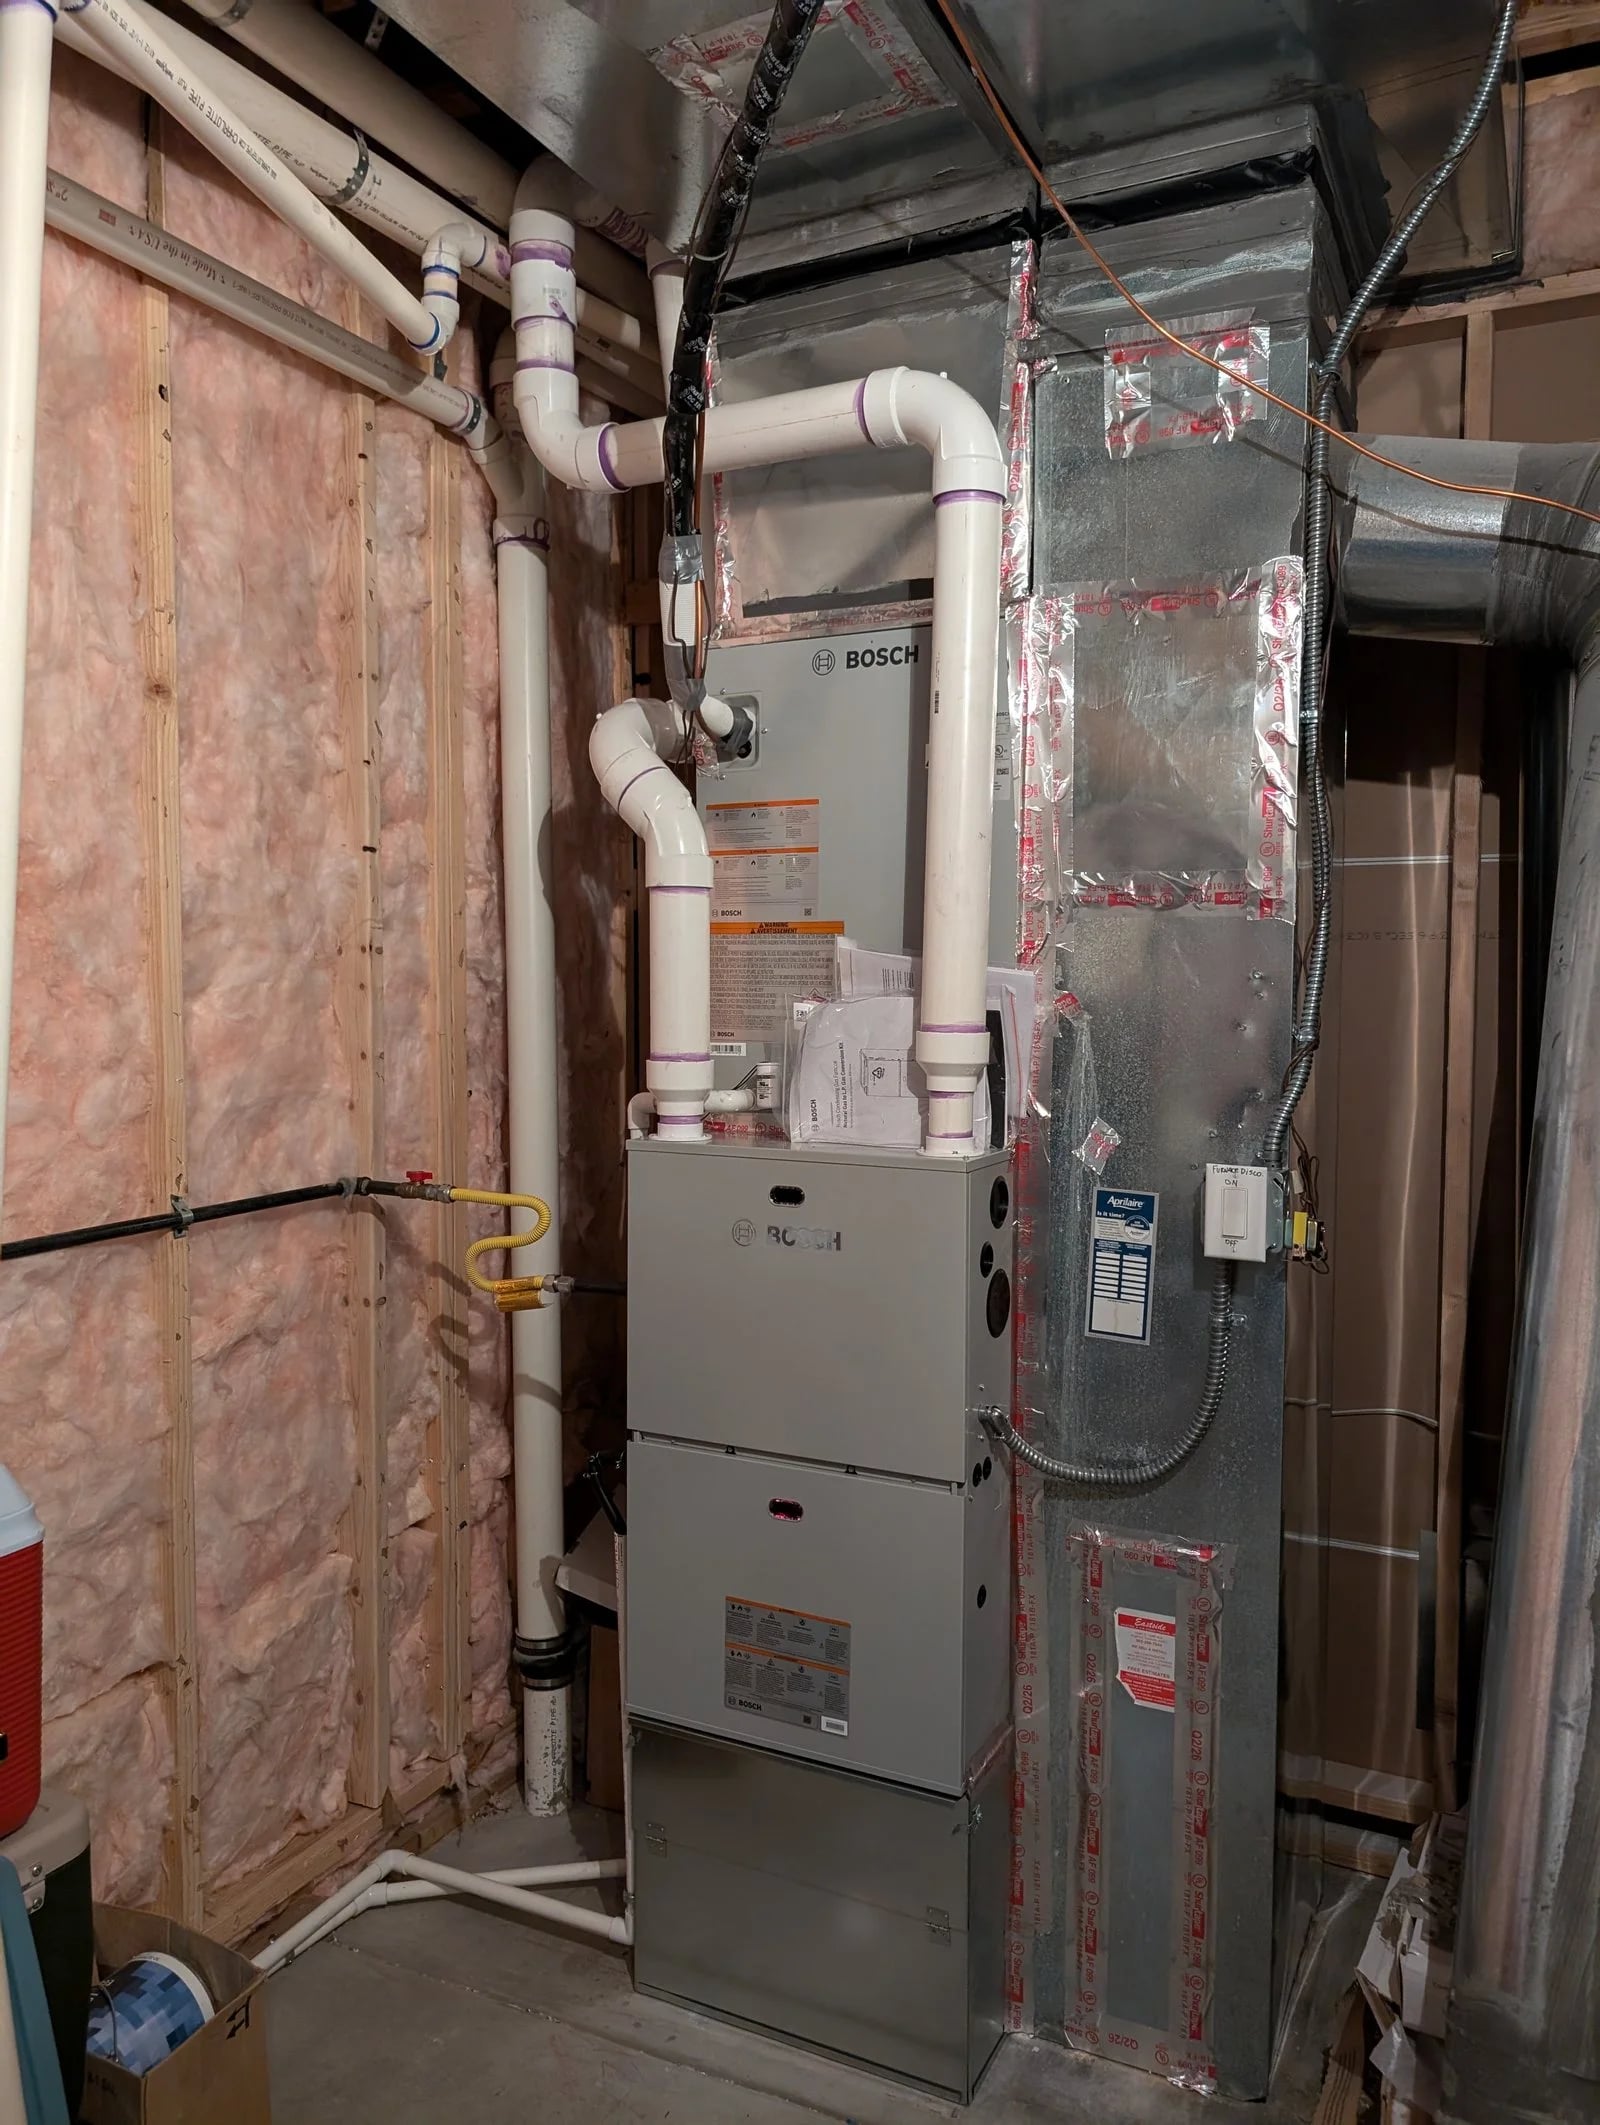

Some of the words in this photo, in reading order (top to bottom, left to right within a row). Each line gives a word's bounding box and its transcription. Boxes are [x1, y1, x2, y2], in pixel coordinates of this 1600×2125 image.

[188, 87, 206, 113] PIPE
[205, 105, 240, 146] CHARLOTTE
[273, 144, 293, 161] PIPE
[137, 227, 160, 250] USA
[163, 241, 179, 260] the
[1009, 461, 1021, 492] Q2/26
[1277, 566, 1287, 581] 099
[846, 645, 919, 670] BOSCH
[1024, 736, 1035, 768] Q2/26
[1034, 815, 1043, 848] 181B-FX
[1263, 867, 1272, 882] 099
[1263, 883, 1272, 896] AF
[1024, 911, 1034, 927] 099
[1025, 928, 1034, 938] AF
[1032, 1022, 1042, 1054] 181B-FX
[1033, 1061, 1041, 1088] 181A-P
[1212, 1165, 1239, 1174] FURNACE
[1225, 1179, 1238, 1187] ON
[1107, 1195, 1144, 1208] Aprilaire
[1123, 1552, 1139, 1562] 099
[1140, 1555, 1152, 1565] AF
[1200, 1562, 1209, 1572] AF
[1199, 1573, 1208, 1588] 099
[1091, 1590, 1099, 1600] AF
[1091, 1601, 1099, 1616] 099
[1134, 1618, 1167, 1631] Eastside
[1016, 1621, 1028, 1659] Shurtape
[1197, 1615, 1209, 1655] Shurtape
[1086, 1653, 1096, 1683] Q2/26
[1127, 1665, 1140, 1673] FREE
[1142, 1667, 1170, 1679] ESTIMATES
[1198, 1664, 1208, 1676] AF
[1198, 1676, 1208, 1692] 099
[738, 1699, 762, 1711] BOSCH
[1023, 1685, 1034, 1714] Q2/26
[549, 1707, 557, 1726] PIPE
[1090, 1709, 1100, 1749] Shurtape
[1191, 1730, 1203, 1761] Q2/26
[1091, 1756, 1099, 1768] AF
[1090, 1768, 1099, 1783] 099
[1195, 1788, 1207, 1831] Shurtape
[1088, 1809, 1098, 1849] Shurtape
[1195, 1838, 1204, 1850] AF
[1088, 1856, 1097, 1868] AF
[1194, 1851, 1204, 1866] 099
[1088, 1869, 1097, 1884] 099
[1192, 1890, 1205, 1932] Shurtape
[1085, 1908, 1096, 1949] Shurtape
[1192, 1939, 1201, 1951] AF
[1085, 1955, 1095, 1967] AF
[1085, 1968, 1095, 1982] 099
[1013, 2005, 1022, 2015] AF
[1189, 1992, 1201, 2033] Shurtape
[1013, 2015, 1023, 2029] 099
[1108, 2032, 1139, 2050] Q2/26
